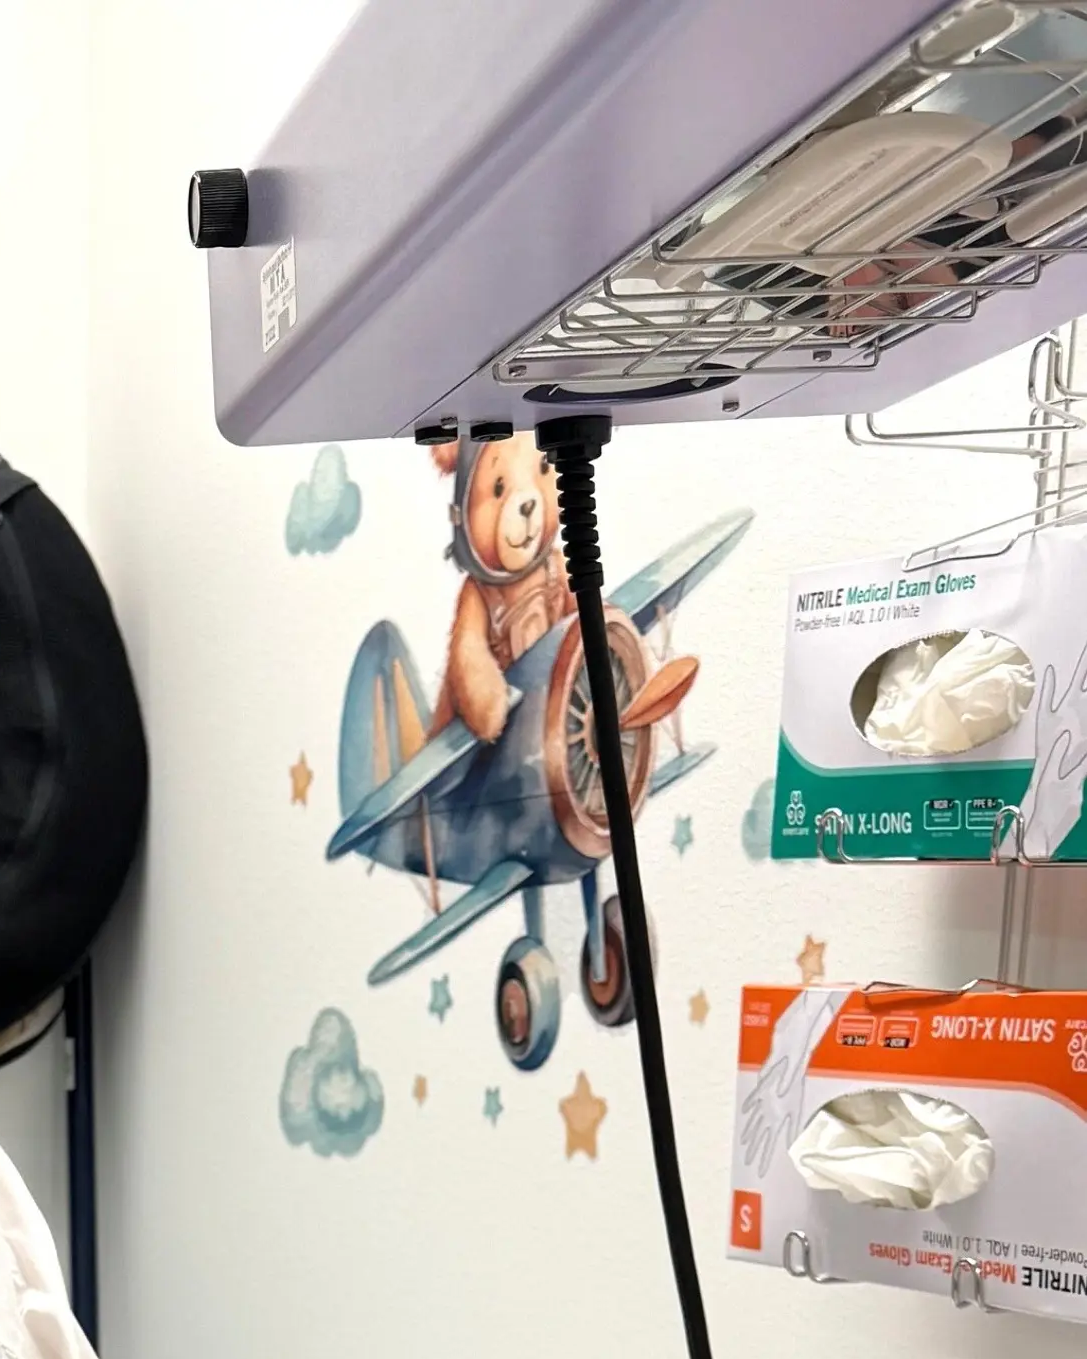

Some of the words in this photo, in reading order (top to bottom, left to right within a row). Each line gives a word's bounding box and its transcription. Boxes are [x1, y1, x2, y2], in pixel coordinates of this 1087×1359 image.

[796, 588, 844, 613] NITRILE
[846, 581, 894, 605] Medical
[896, 579, 931, 599] Exam
[935, 573, 976, 594] Gloves
[794, 615, 841, 632] Powder-free
[848, 609, 866, 625] AQL
[893, 603, 920, 620] White
[814, 813, 854, 835] SATN
[858, 811, 913, 834] X-LONG
[930, 1014, 996, 1040] X-LONG
[999, 1017, 1057, 1043] SATIN
[739, 1203, 753, 1233] S
[922, 1229, 952, 1250] White
[962, 1236, 982, 1254] 1.0
[986, 1239, 1010, 1257] AQL
[869, 1242, 911, 1267] Gloves
[915, 1249, 952, 1274] Exam
[1022, 1266, 1087, 1296] NITRILE
